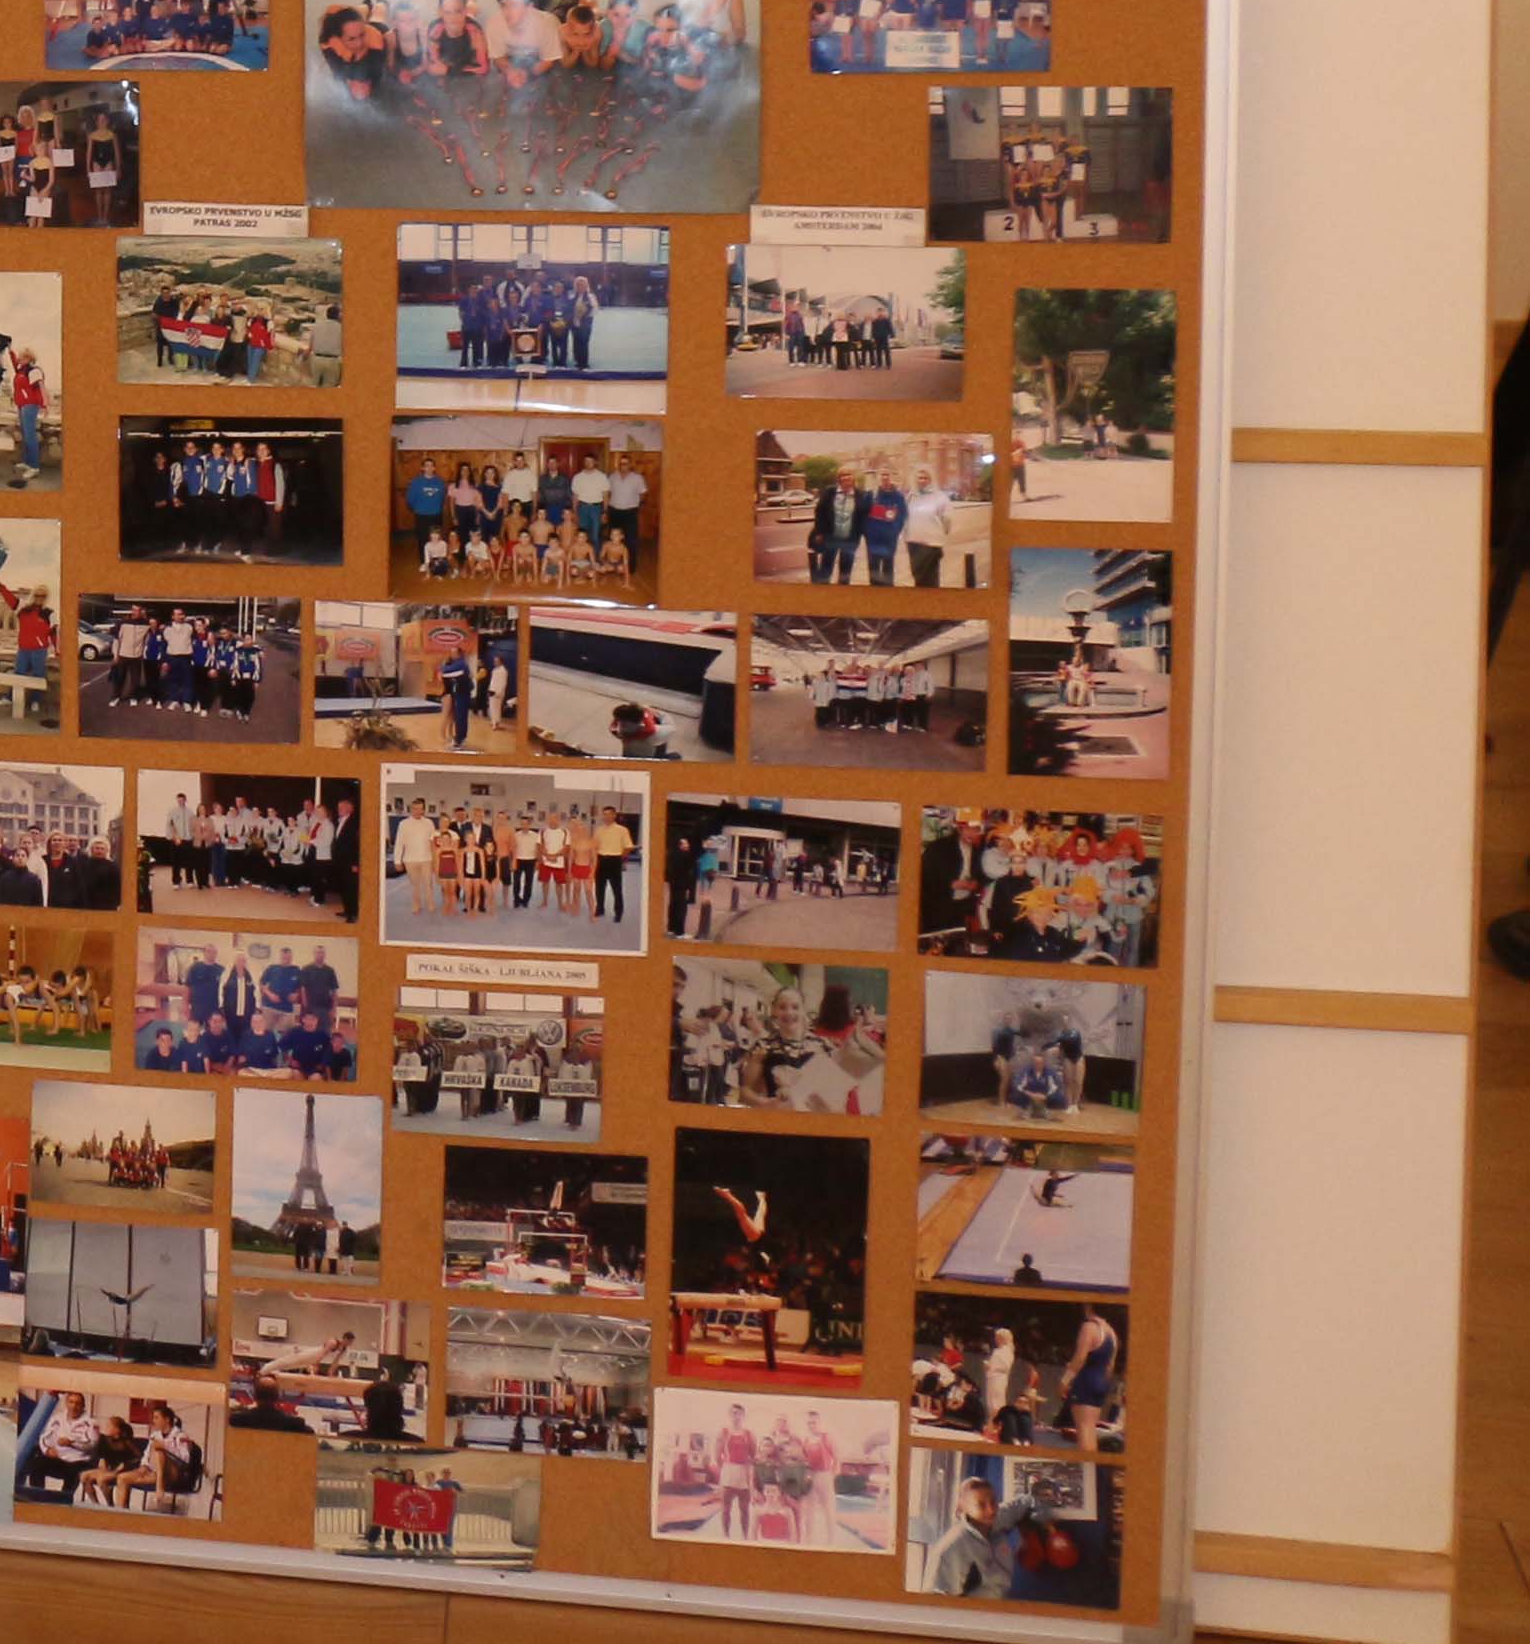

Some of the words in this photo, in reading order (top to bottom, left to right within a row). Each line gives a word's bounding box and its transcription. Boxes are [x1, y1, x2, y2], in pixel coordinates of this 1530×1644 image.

[148, 205, 202, 217] EVROPSKO
[204, 206, 262, 218] PRVENSTVO
[264, 208, 272, 218] U
[193, 218, 231, 228] PATRAS
[1004, 216, 1014, 231] 2
[1089, 222, 1100, 236] 3
